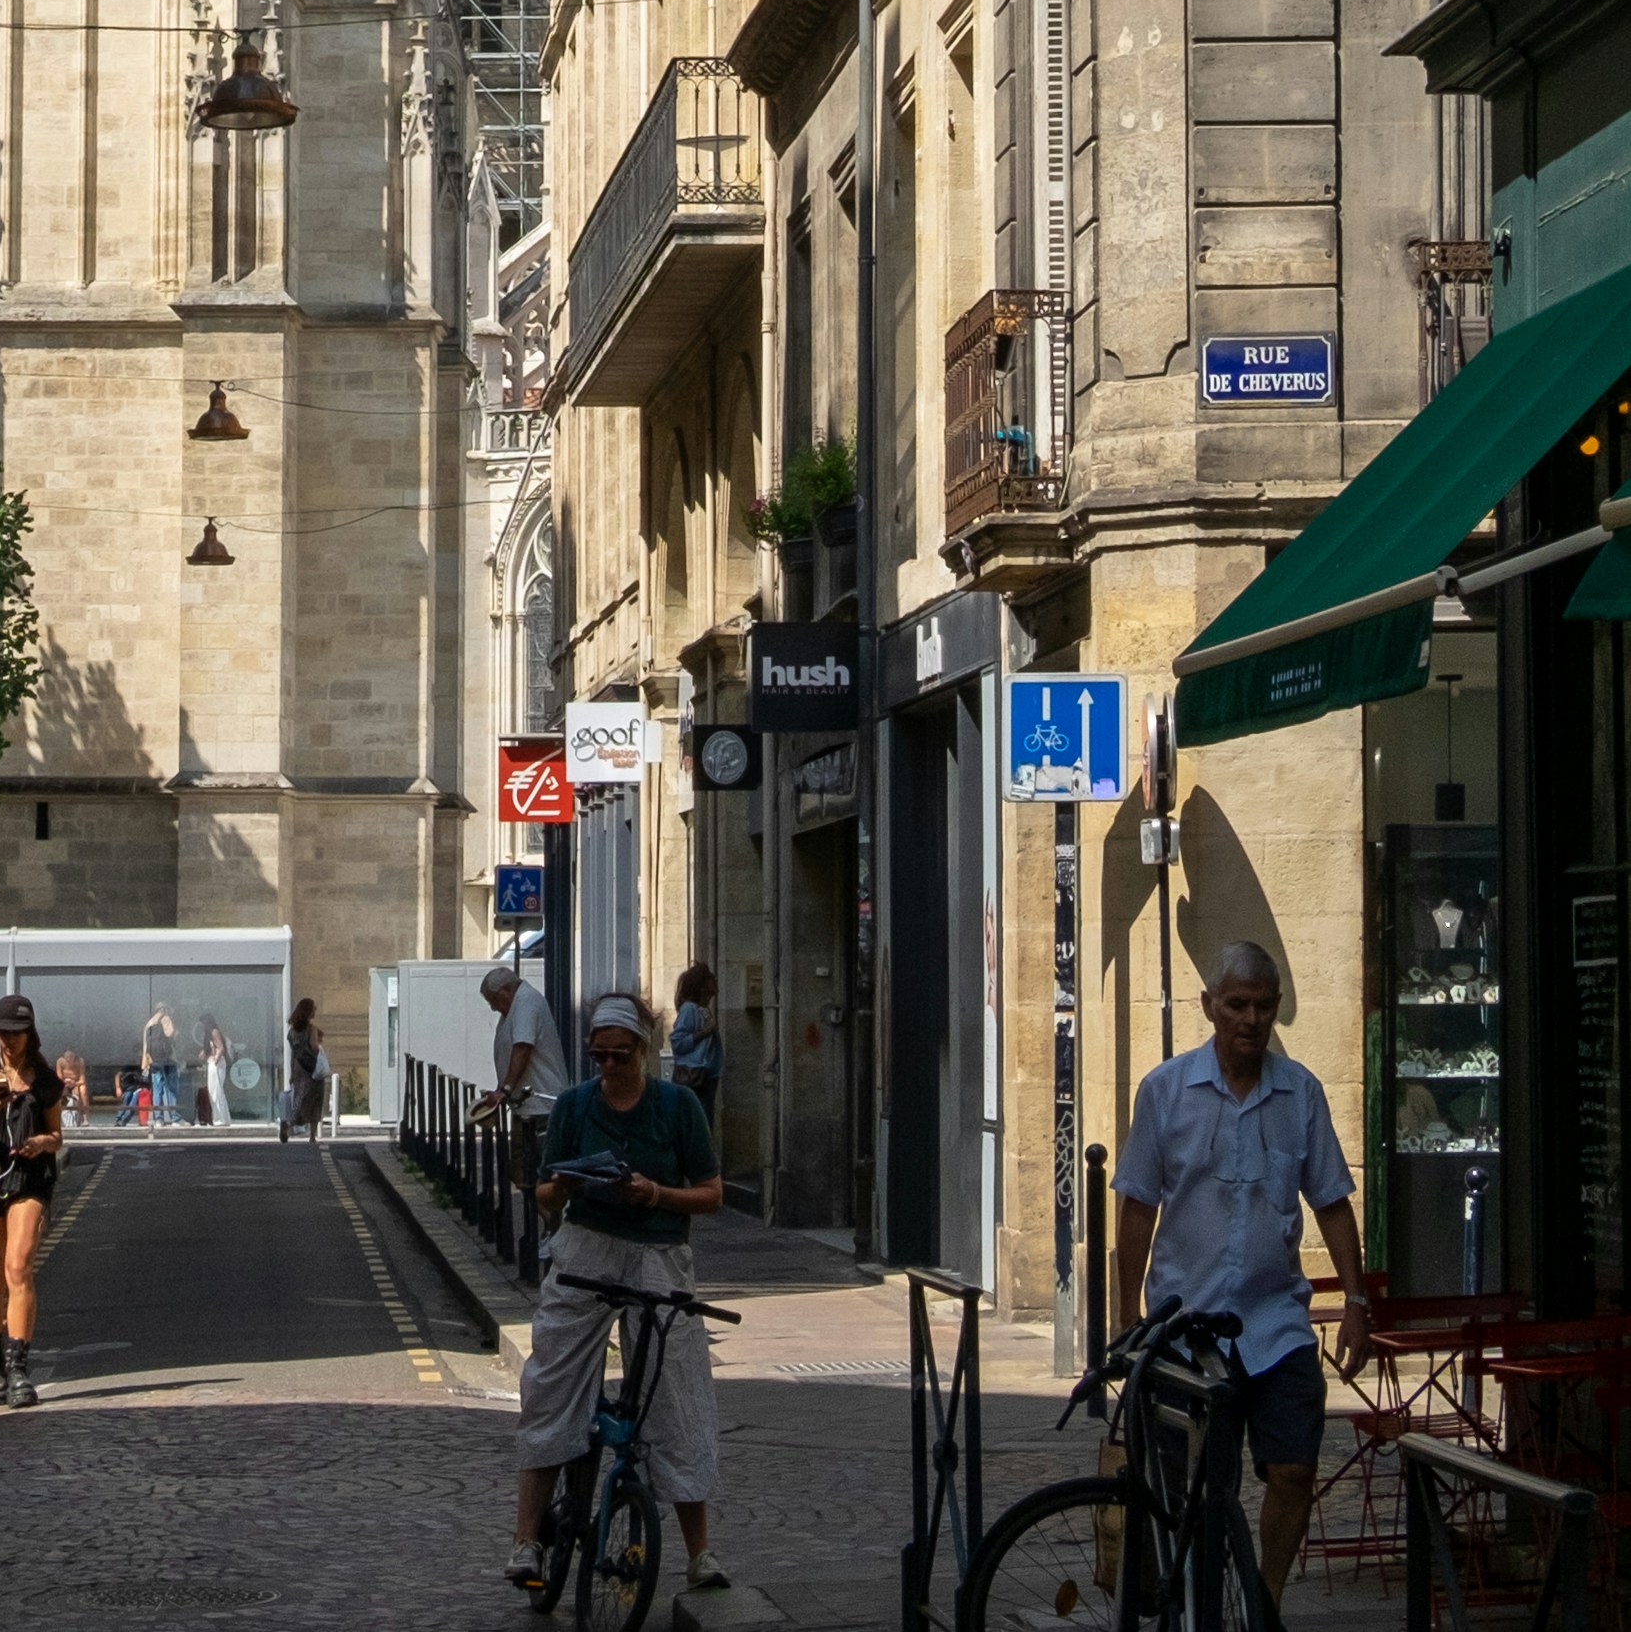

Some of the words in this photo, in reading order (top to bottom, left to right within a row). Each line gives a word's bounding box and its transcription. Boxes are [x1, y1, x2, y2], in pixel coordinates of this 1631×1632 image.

[1243, 346, 1290, 365] RUE
[1209, 374, 1232, 393] DE
[1238, 372, 1326, 392] CHEVERUS
[762, 656, 850, 686] hush
[762, 687, 789, 695] HAIR
[806, 686, 849, 695] BEAUTY
[571, 718, 641, 763] goof
